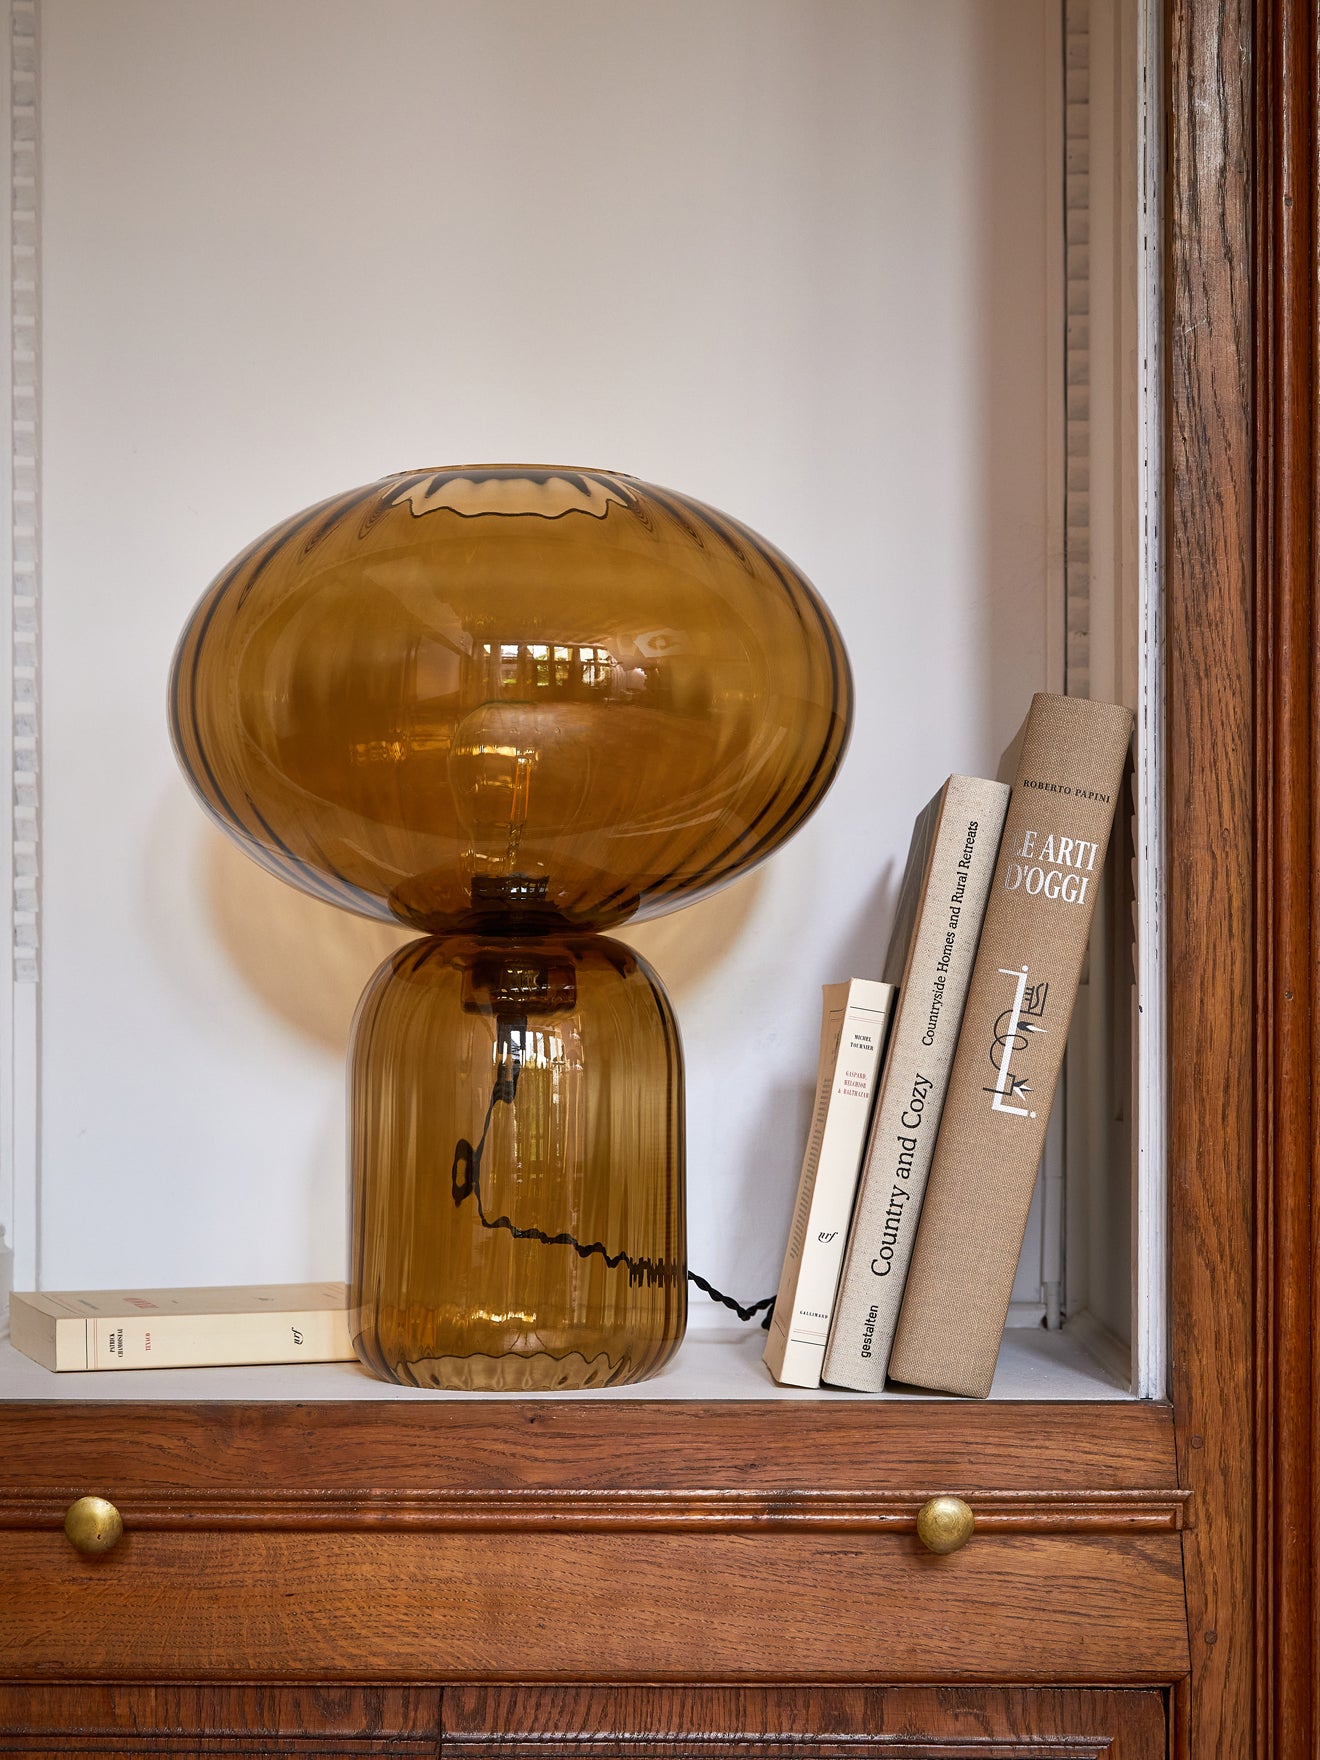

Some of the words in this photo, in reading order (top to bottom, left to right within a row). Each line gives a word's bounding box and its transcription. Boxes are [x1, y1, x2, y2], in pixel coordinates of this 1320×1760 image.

[1023, 780, 1071, 795] ROBERTO
[1075, 788, 1111, 803] PAPINI
[958, 820, 979, 869] Retreats
[1038, 834, 1099, 871] ARTI
[951, 871, 968, 903] Rural
[1004, 864, 1090, 905] D'OGGI
[948, 906, 961, 929] and
[936, 931, 956, 973] Homes
[922, 975, 946, 1046] Countryside
[850, 1042, 874, 1051] TOURNIER
[854, 1034, 872, 1042] MICHEL
[843, 1089, 870, 1099] BALTHAZAR
[844, 1080, 867, 1089] MELCHIOR
[901, 1072, 933, 1129] Cozy
[895, 1136, 917, 1180] and
[871, 1185, 910, 1277] Country
[799, 1310, 829, 1319] GALLIMARD
[861, 1305, 879, 1358] gestalten
